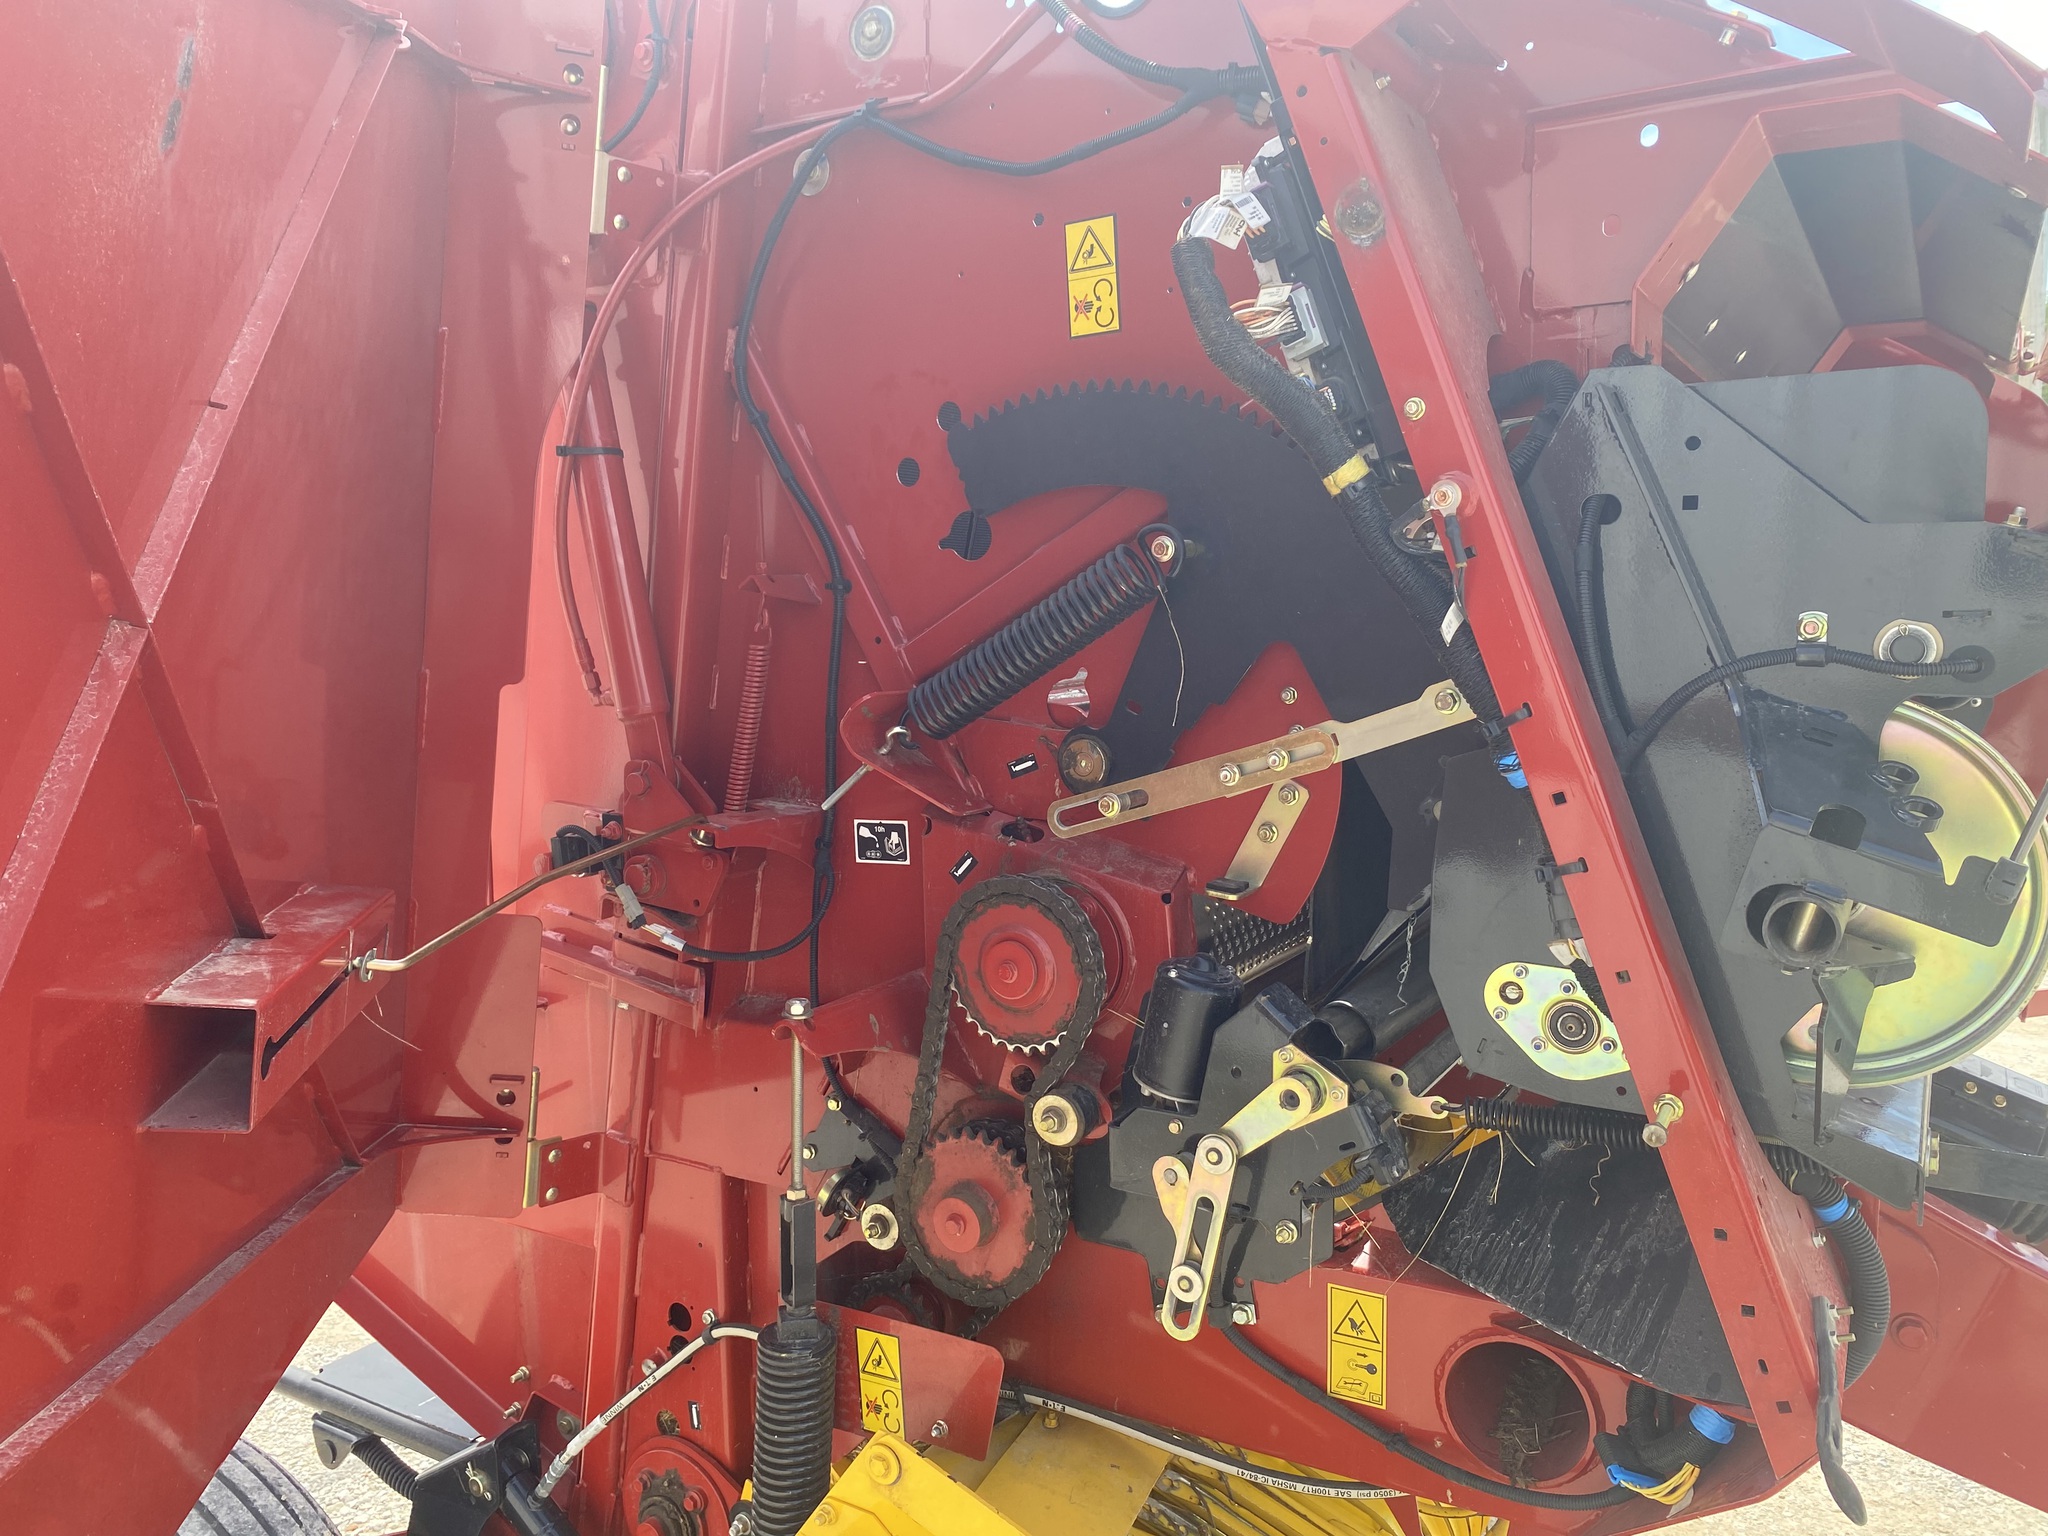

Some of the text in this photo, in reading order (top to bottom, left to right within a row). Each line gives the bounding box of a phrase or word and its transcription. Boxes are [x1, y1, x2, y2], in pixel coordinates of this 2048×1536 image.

[1236, 1469, 1269, 1488] IC-84/41
[1270, 1478, 1297, 1491] MSHA
[1301, 1485, 1331, 1497] 100R17
[1334, 1489, 1352, 1498] SAE
[1356, 1490, 1372, 1499] psi)
